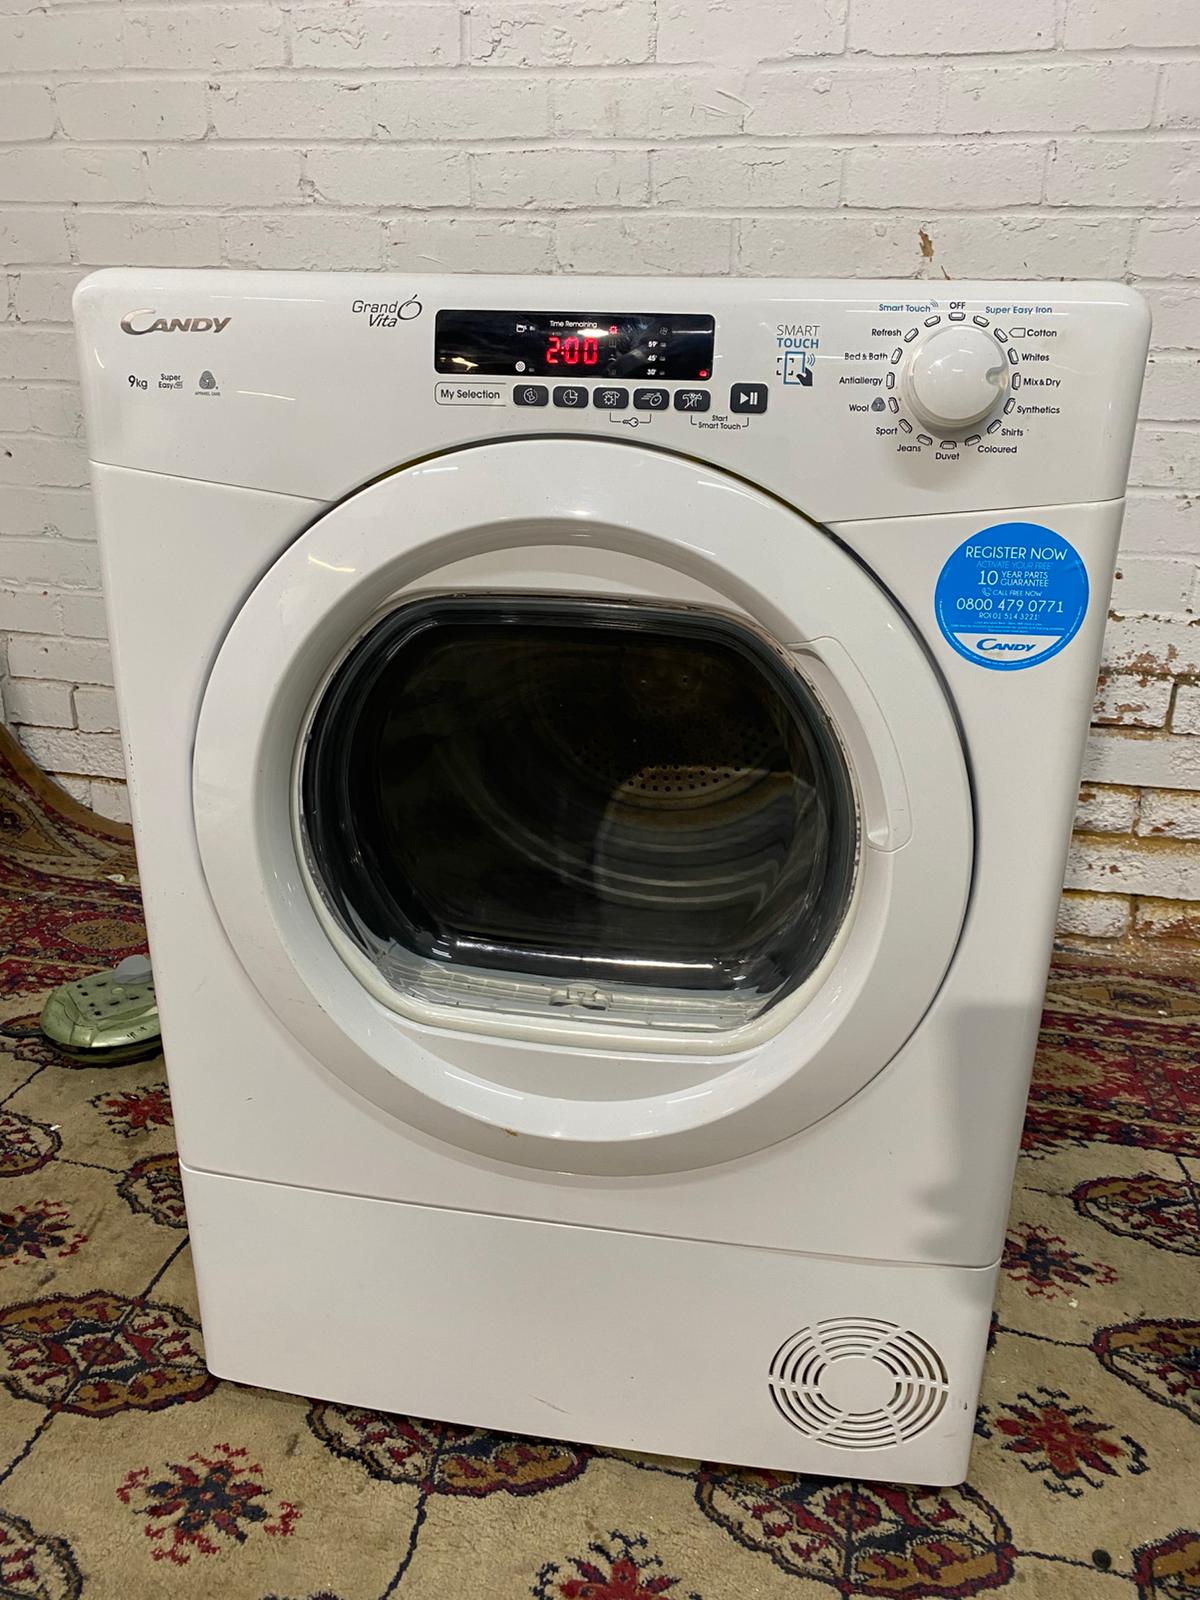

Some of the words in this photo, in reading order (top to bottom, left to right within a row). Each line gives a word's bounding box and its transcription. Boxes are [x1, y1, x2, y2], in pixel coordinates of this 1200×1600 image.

[352, 300, 398, 313] Grand
[879, 303, 904, 312] Smart
[906, 303, 931, 313] Touch
[949, 301, 966, 310] OFF
[985, 305, 1010, 315] Super
[1013, 306, 1033, 315] Easy
[1036, 306, 1053, 314] Iron
[120, 307, 232, 336] CANDY
[369, 313, 398, 327] Vita
[565, 320, 598, 329] Remaining
[776, 324, 820, 337] SMART
[871, 328, 902, 337] Refresh
[1027, 328, 1057, 338] Cotton
[776, 337, 819, 349] TOUCH
[546, 336, 599, 365] 2:00
[844, 352, 861, 361] Bed
[869, 352, 888, 361] Bath
[1021, 353, 1050, 362] Whites
[128, 374, 148, 390] 9kg
[160, 373, 181, 382] Super
[839, 376, 883, 387] Antiallergy
[158, 380, 174, 390] Easy
[440, 388, 454, 400] My
[456, 388, 501, 400] Selection
[849, 403, 870, 412] Wool
[1016, 405, 1060, 415] Synthetics
[698, 421, 718, 430] Smart
[719, 422, 741, 431] Touch
[875, 426, 898, 436] Sport
[1001, 428, 1024, 437] Shirts
[896, 444, 921, 453] Jeans
[977, 444, 1017, 454] Coloured
[935, 452, 960, 461] Duvet
[965, 545, 1027, 559] REGISTER
[1030, 547, 1068, 561] NOW
[976, 560, 1009, 569] ACTIVATE
[978, 570, 998, 585] 10
[1001, 570, 1022, 579] YEAR
[1024, 571, 1049, 580] PARTS
[1000, 578, 1049, 587] GUARANTEE
[956, 597, 993, 611] 0800
[998, 598, 1024, 612] 479
[1028, 600, 1064, 613] 0771
[976, 638, 1036, 652] CANDY
